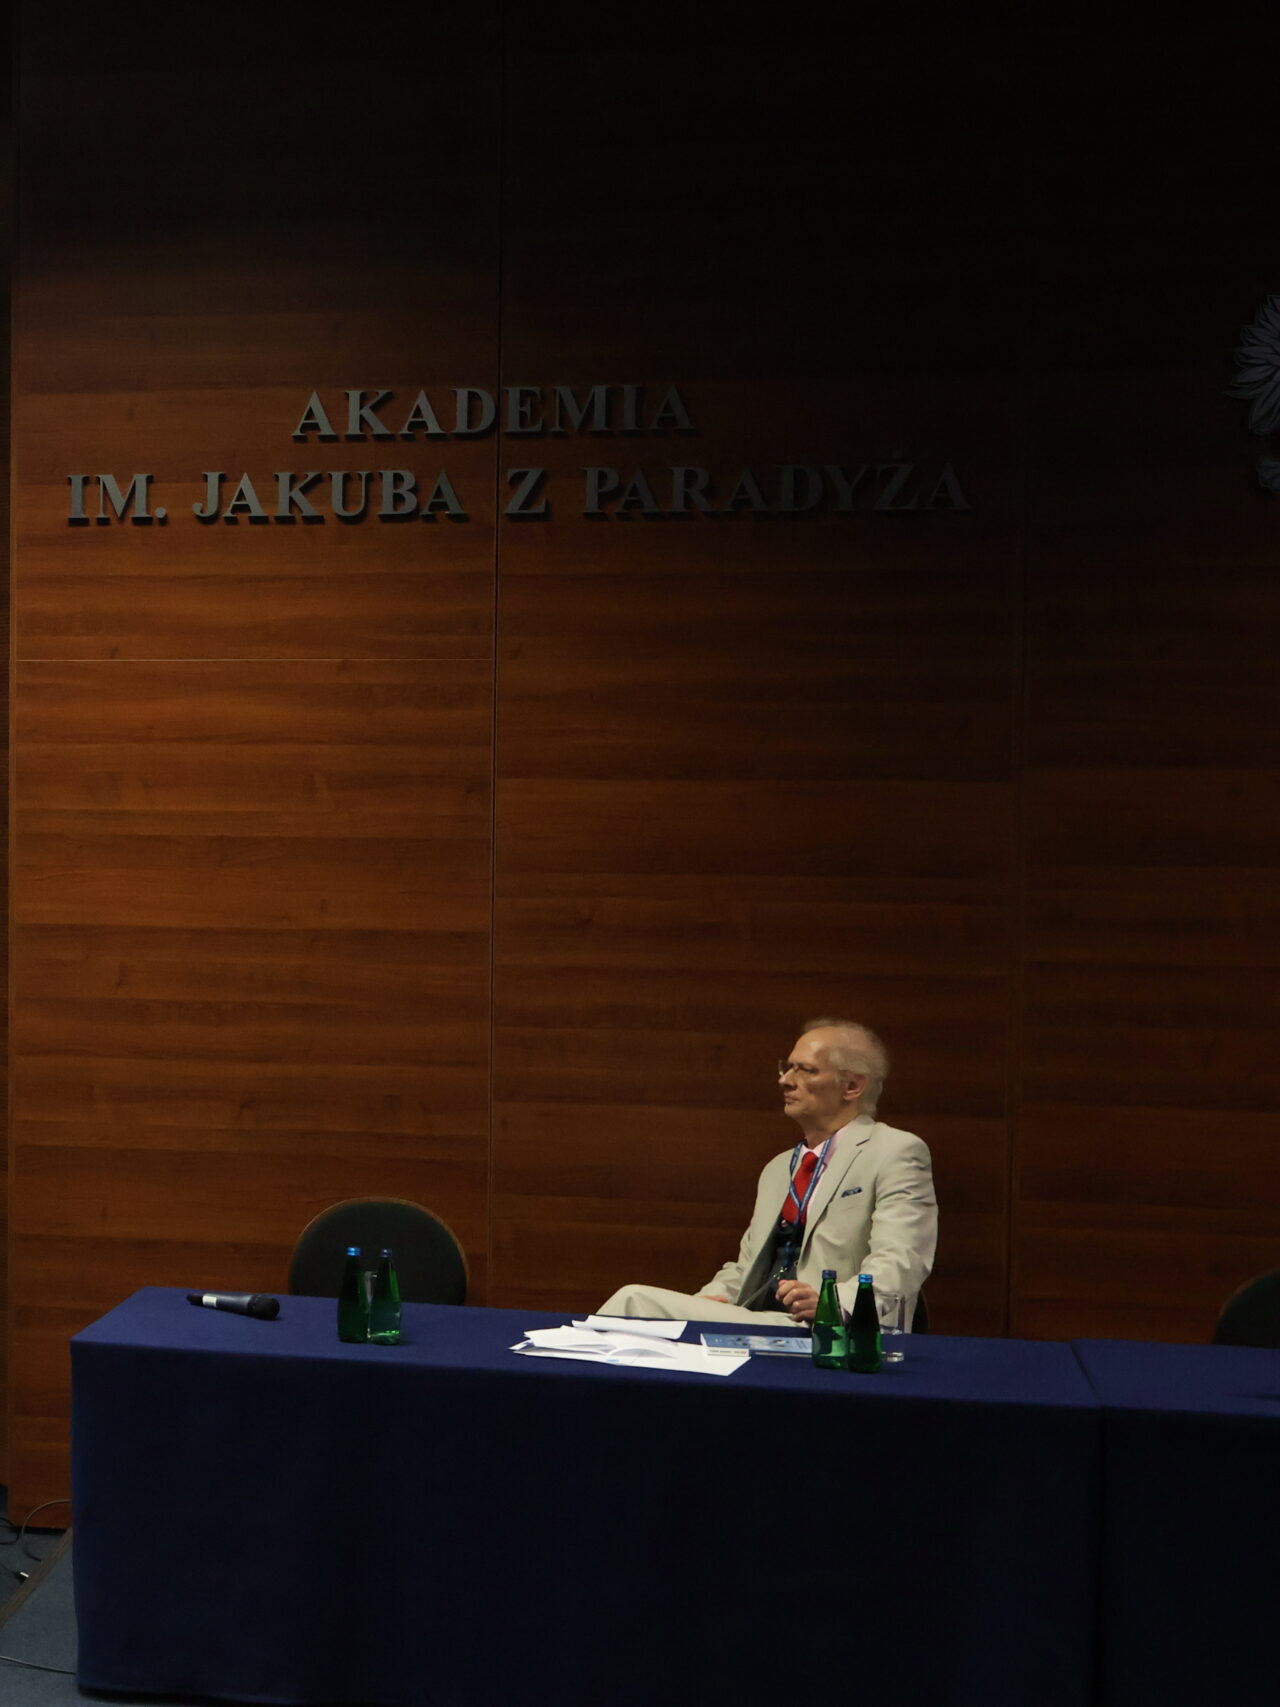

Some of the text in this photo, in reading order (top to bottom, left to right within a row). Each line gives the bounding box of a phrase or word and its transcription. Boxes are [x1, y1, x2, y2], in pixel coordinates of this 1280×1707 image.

[291, 384, 696, 439] AKADEMIA
[66, 450, 973, 523] IM. JAKUBA Z PARADYŻA
